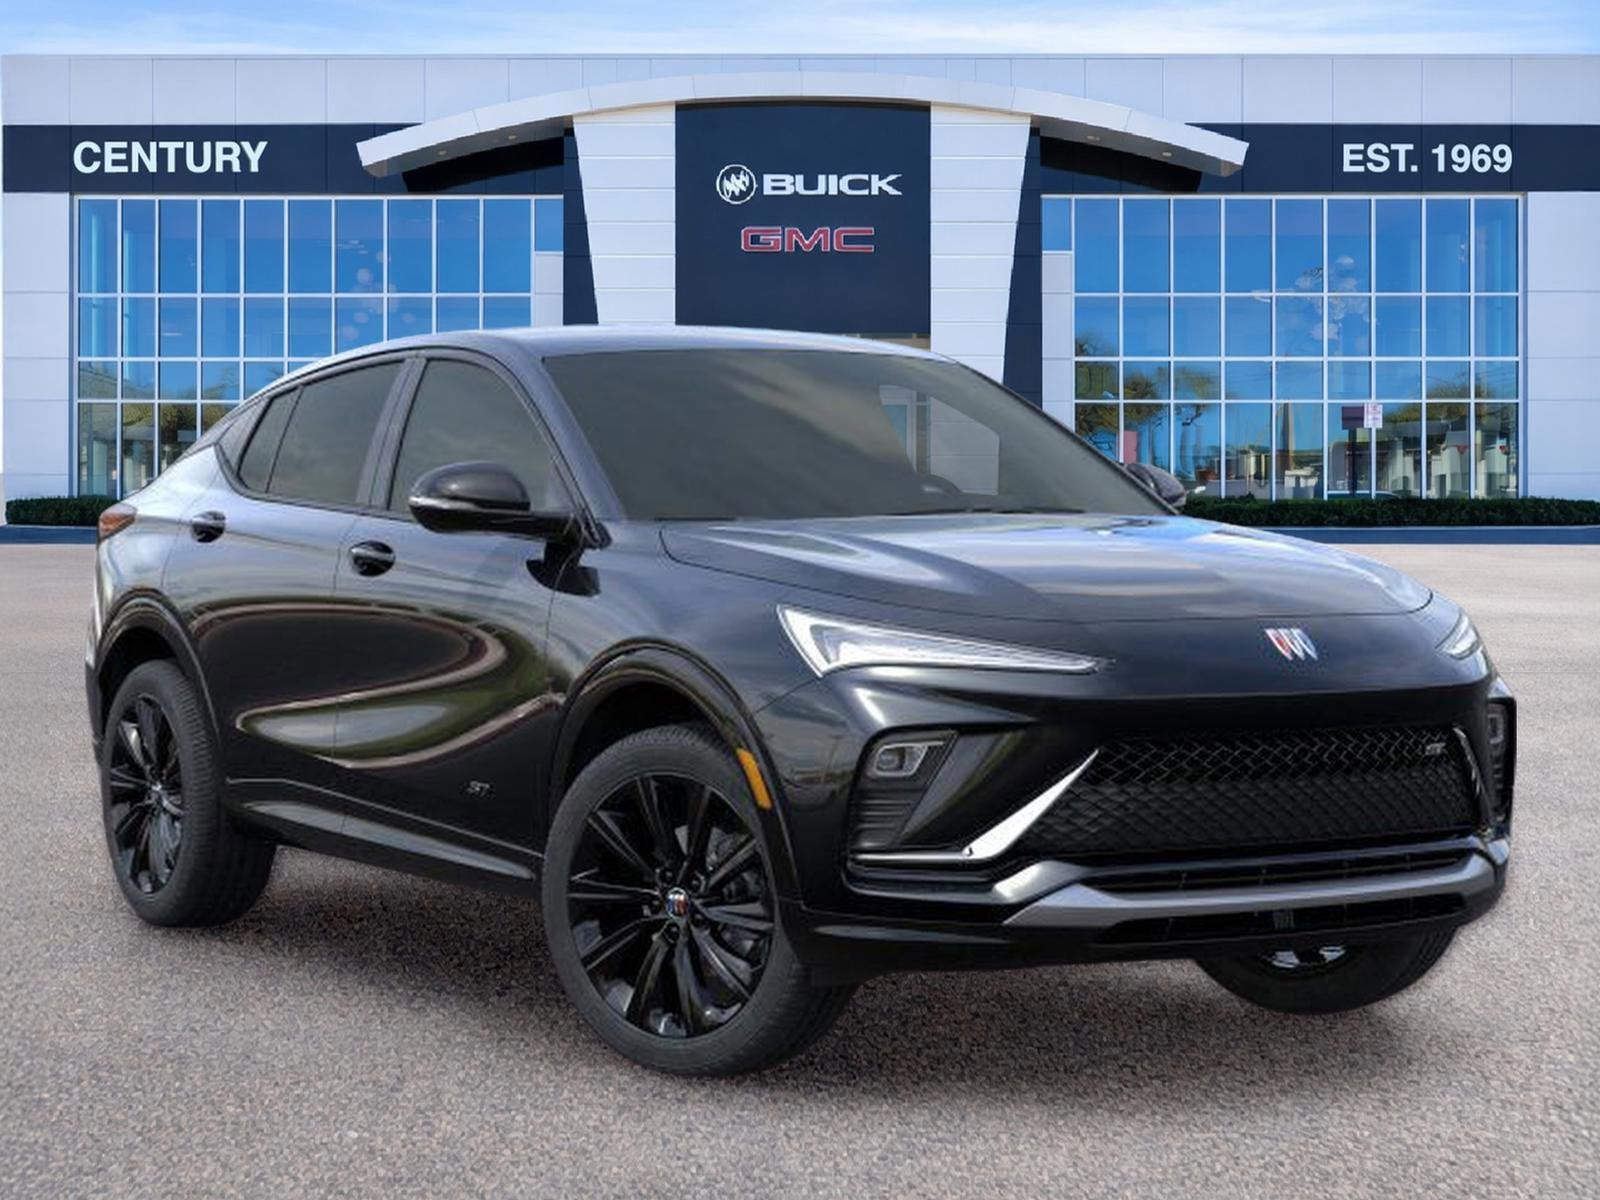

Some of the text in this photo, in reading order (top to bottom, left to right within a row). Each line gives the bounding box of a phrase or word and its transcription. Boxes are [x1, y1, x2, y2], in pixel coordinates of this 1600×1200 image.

[73, 141, 268, 174] CENTURY
[1342, 143, 1513, 173] EST. 1969
[762, 174, 902, 196] BUICK
[741, 226, 875, 253] GMC
